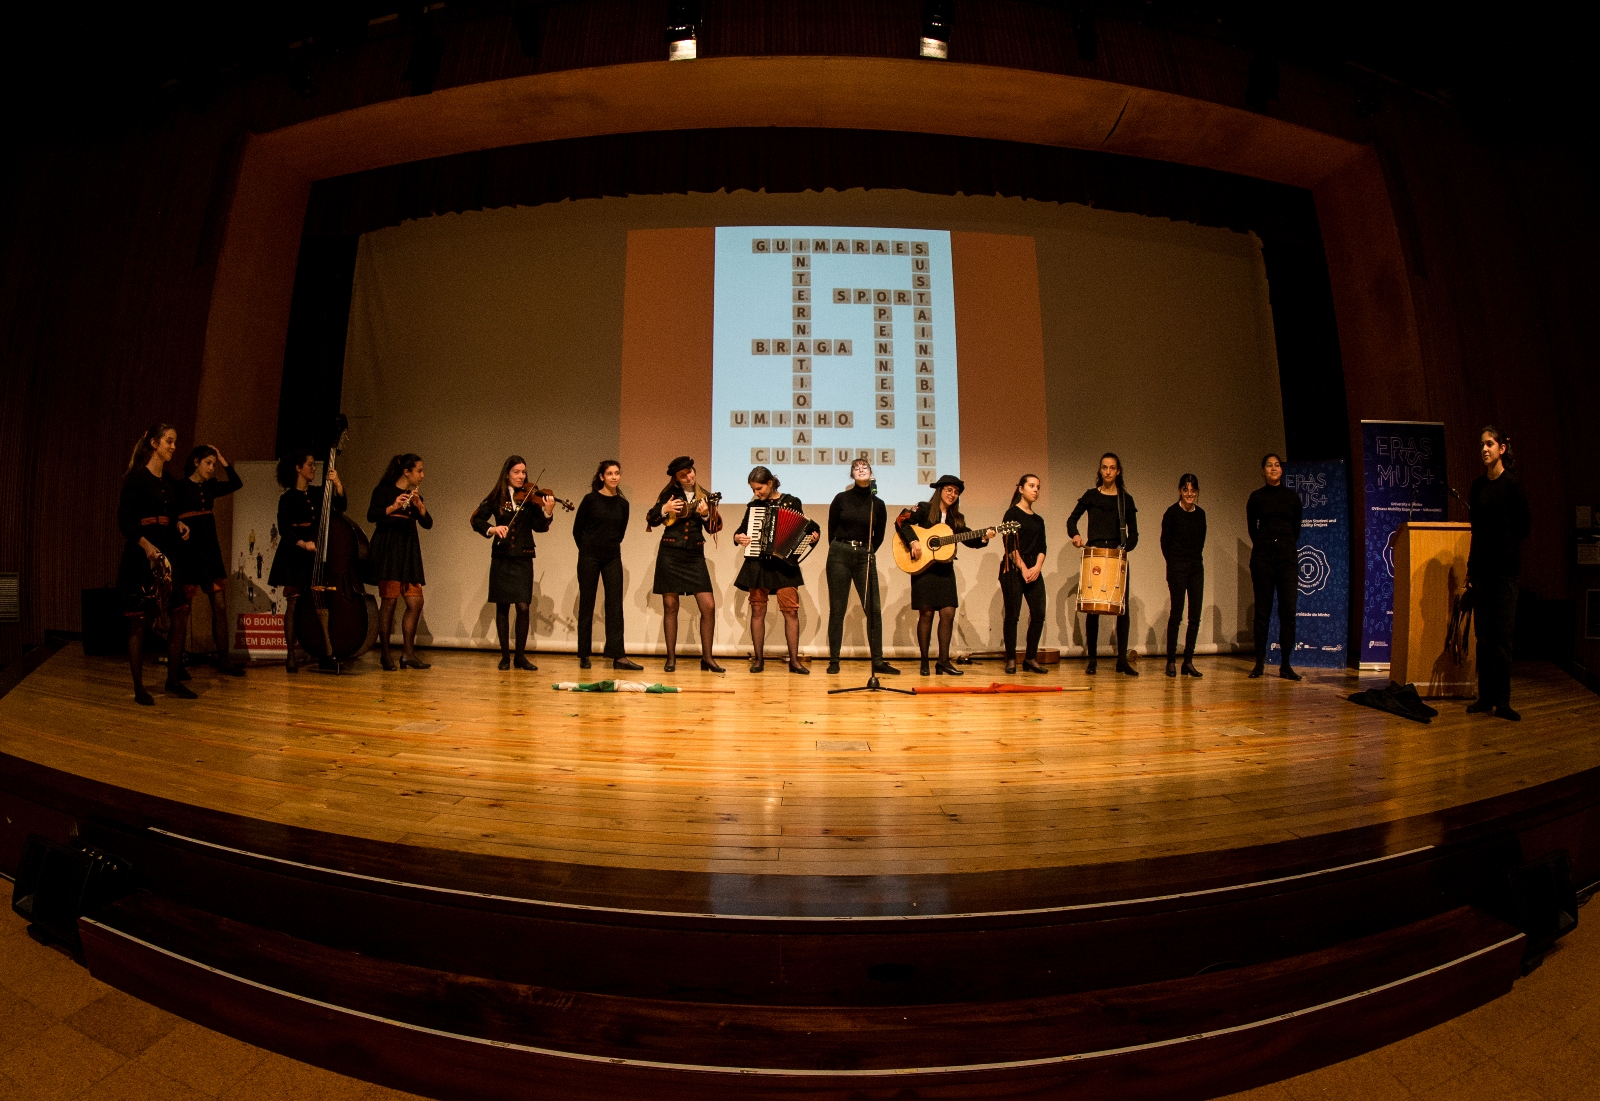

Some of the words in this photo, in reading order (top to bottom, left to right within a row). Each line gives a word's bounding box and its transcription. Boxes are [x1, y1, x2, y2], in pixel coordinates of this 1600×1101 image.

[756, 240, 927, 254] GUIMARAES
[837, 290, 929, 304] SPORT
[756, 341, 851, 353] BRAGA
[796, 240, 809, 462] INTERNATIONAL
[876, 290, 892, 426] OPENNESS
[914, 243, 933, 482] SUSTAINABILITY
[735, 413, 851, 426] UMINHO
[755, 450, 893, 463] CULTURE
[1298, 492, 1329, 509] US+
[239, 617, 252, 626] NO
[253, 617, 285, 626] BOUND
[240, 637, 258, 646] SEM
[260, 637, 288, 646] BARRE
